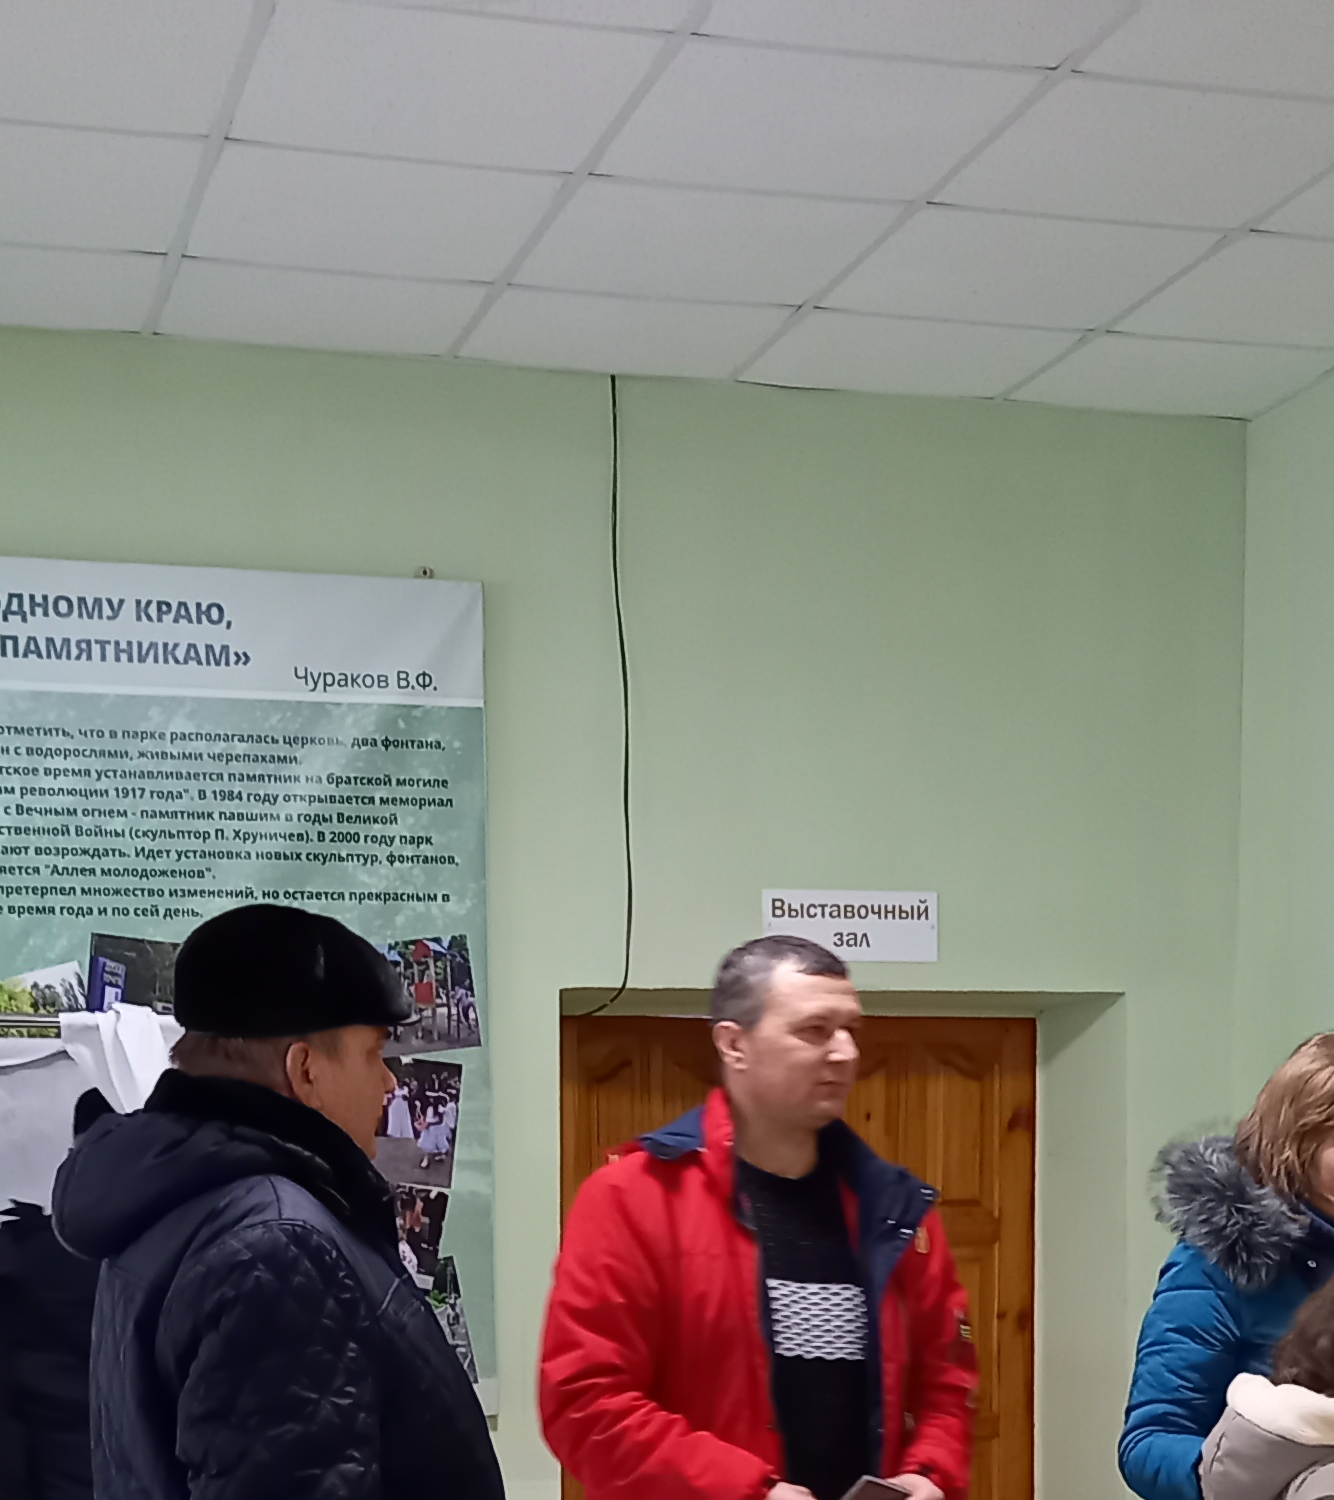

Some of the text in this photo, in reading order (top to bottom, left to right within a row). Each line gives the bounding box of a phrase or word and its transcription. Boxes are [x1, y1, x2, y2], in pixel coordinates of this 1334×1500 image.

[135, 598, 232, 631] КРАЮ,
[0, 634, 251, 668] ПАМЯТНИКАМ»
[293, 665, 438, 694] Чураков В.Ф.
[74, 823, 126, 840] Войны
[128, 825, 211, 845] (скульптор
[214, 827, 230, 842] П.
[232, 828, 314, 846] Хруничев).
[316, 829, 326, 844] В
[328, 830, 361, 846] 2000
[363, 833, 397, 848] году
[398, 834, 434, 851] парк
[33, 845, 131, 861] возрождать.
[134, 845, 172, 863] Идет
[174, 848, 252, 864] установка
[255, 850, 303, 863] новых
[305, 851, 383, 868] скульптур,
[385, 849, 460, 868] фонтанов,
[7, 903, 56, 920] время
[59, 904, 94, 920] года
[97, 905, 108, 918] и
[111, 905, 131, 918] по
[133, 903, 160, 919] сей
[162, 906, 204, 922] день.
[771, 897, 930, 921] Выставочный
[832, 931, 871, 949] зал
